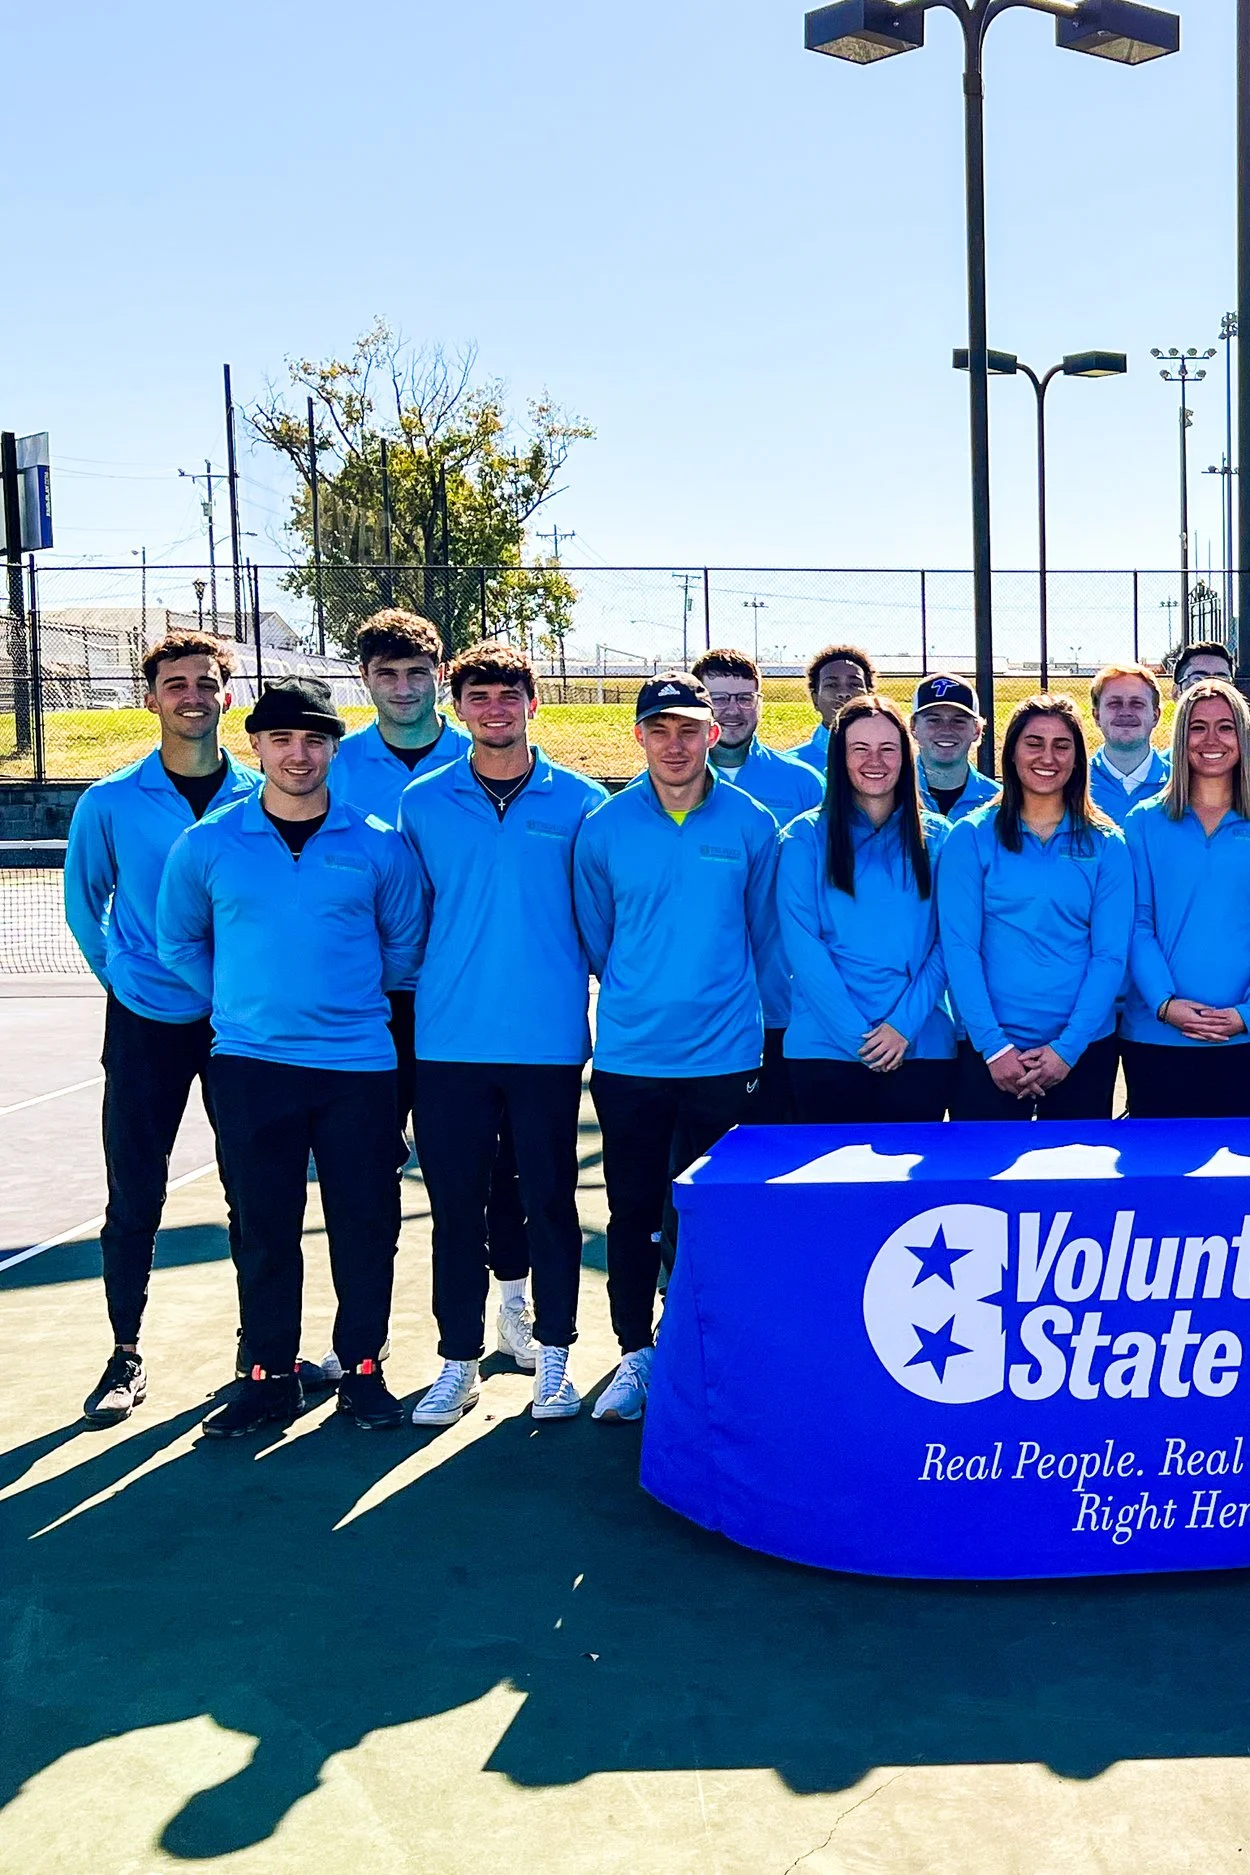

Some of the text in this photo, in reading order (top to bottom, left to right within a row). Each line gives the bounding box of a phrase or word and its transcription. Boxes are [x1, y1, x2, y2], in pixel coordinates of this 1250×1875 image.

[1008, 1304, 1243, 1401] State
[917, 1441, 1003, 1481] Real
[1011, 1439, 1144, 1493] People.
[1158, 1436, 1244, 1476] Real
[1071, 1491, 1178, 1545] Right
